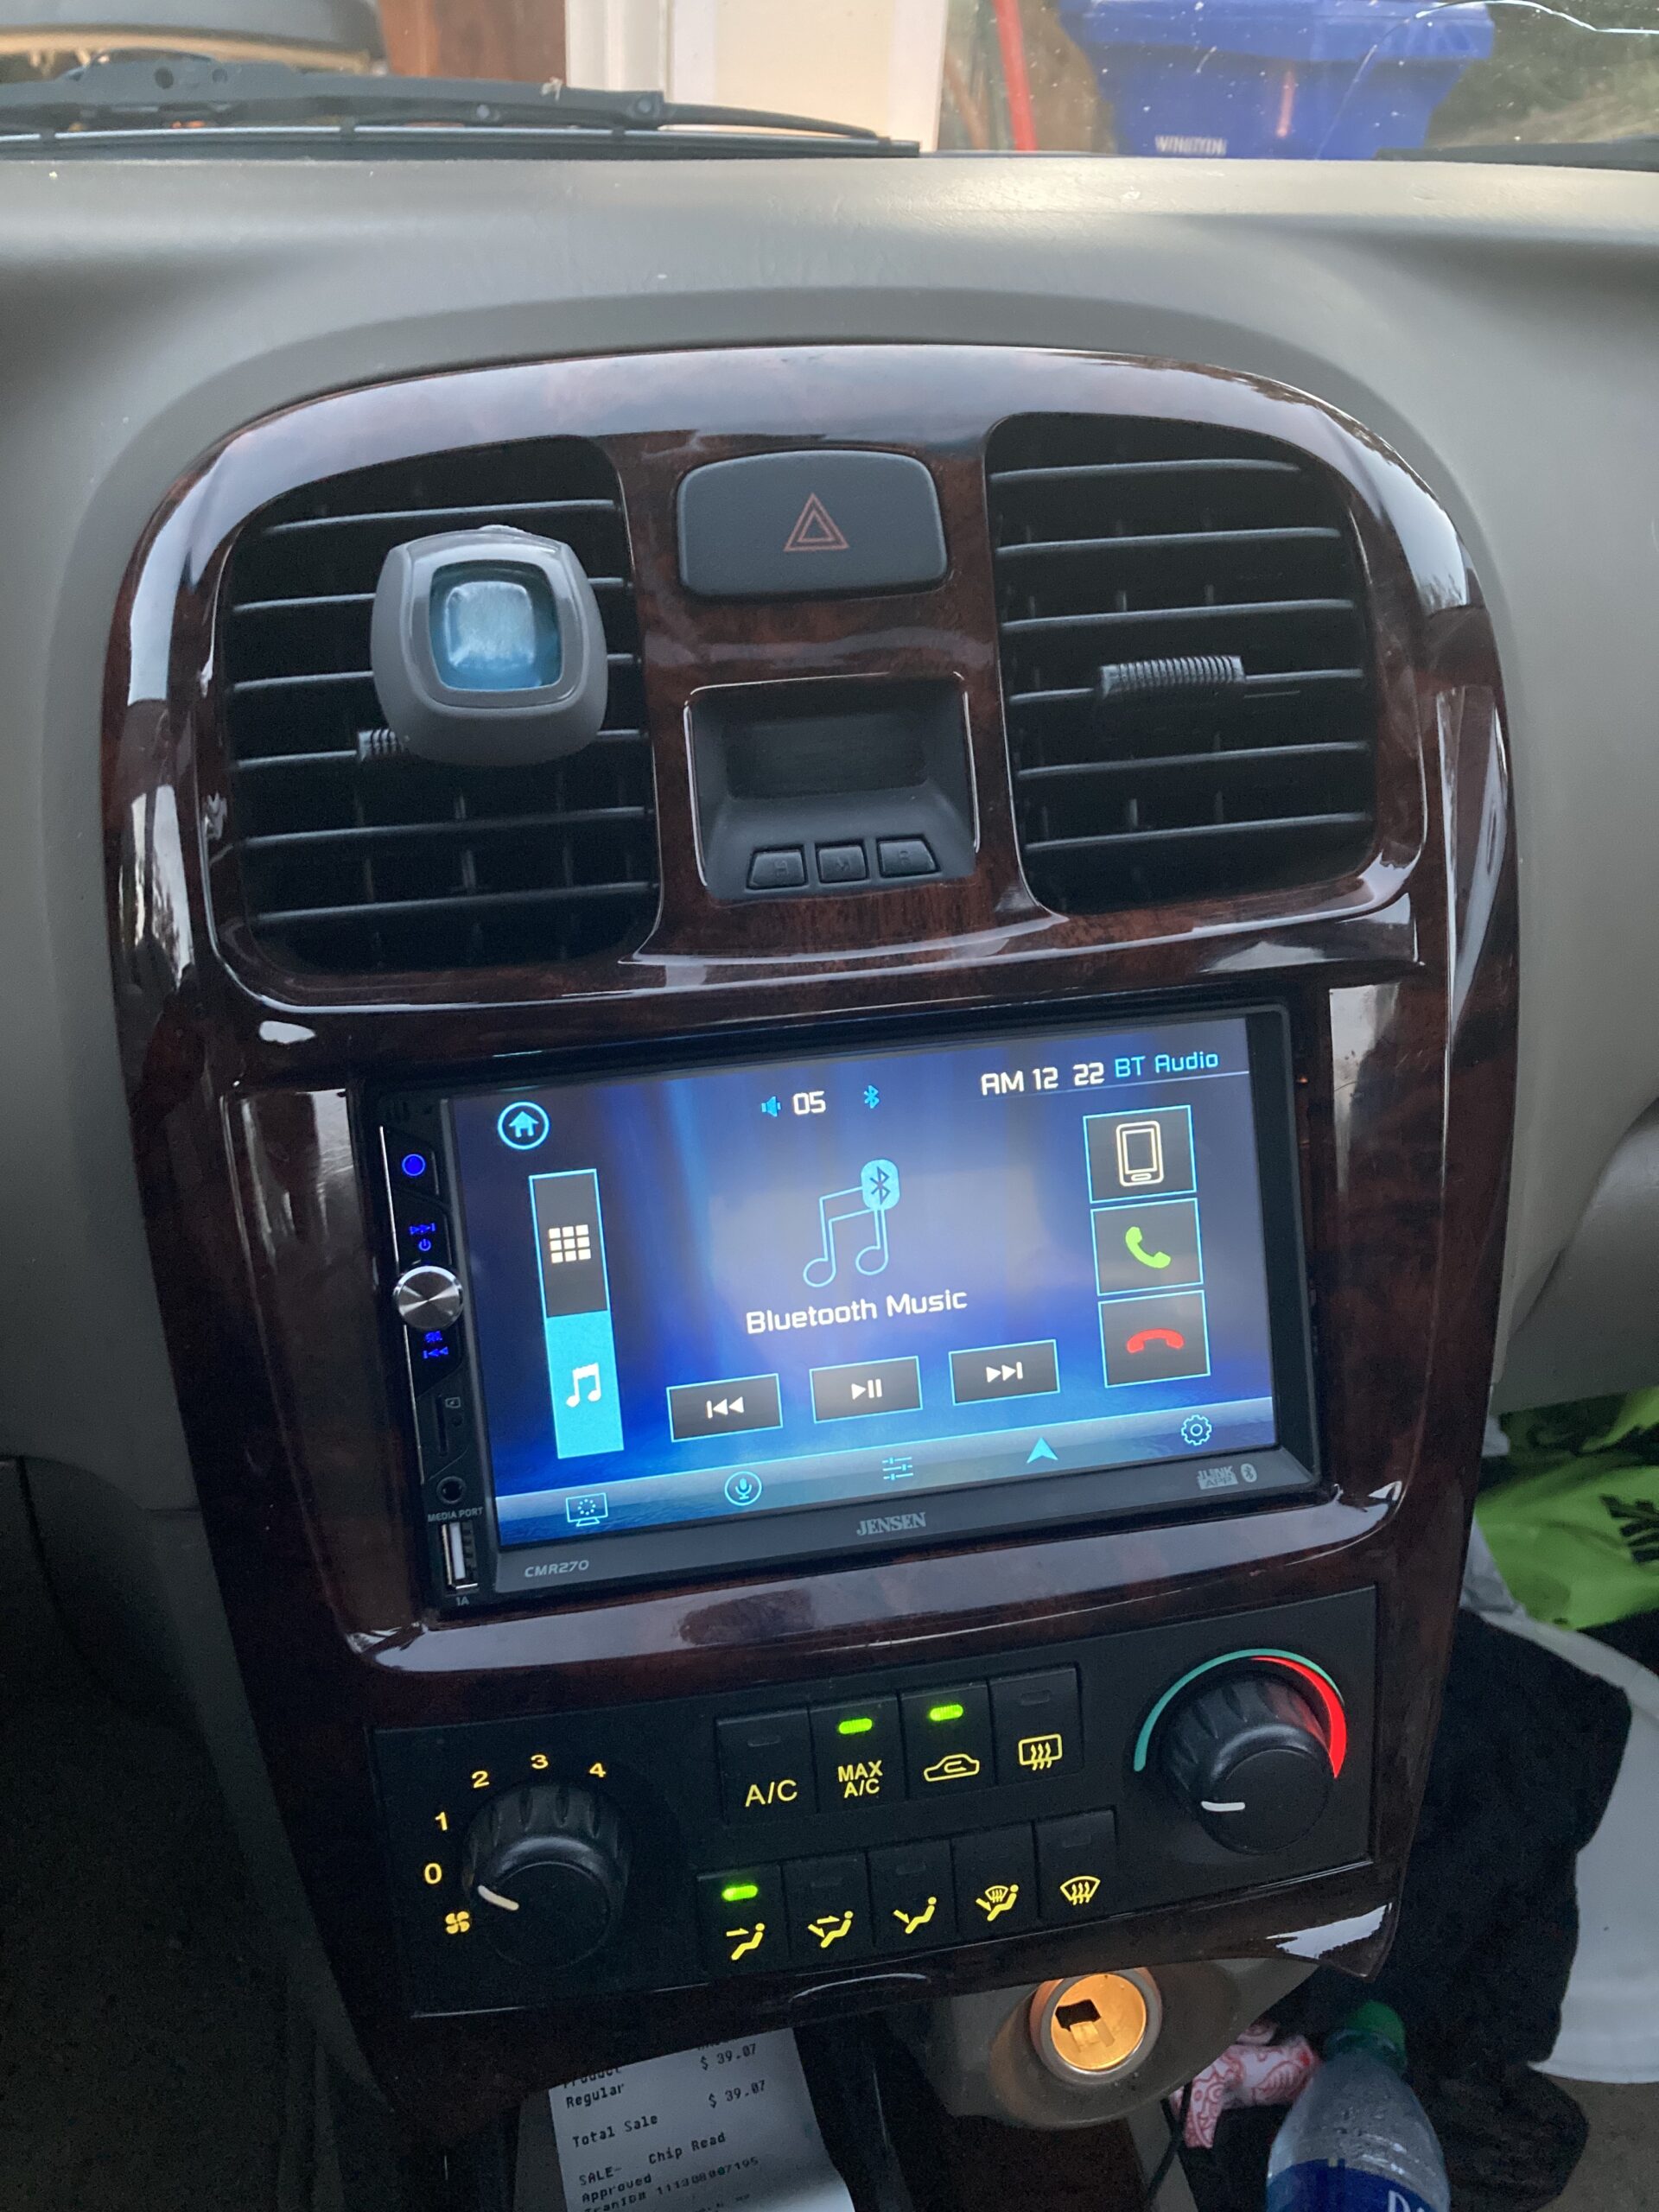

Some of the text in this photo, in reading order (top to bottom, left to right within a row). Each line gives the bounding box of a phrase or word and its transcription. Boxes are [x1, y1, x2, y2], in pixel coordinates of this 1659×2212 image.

[1115, 1051, 1219, 1078] BT Audio
[981, 1062, 1105, 1096] AM 12 22
[793, 1090, 827, 1116] 05
[746, 1289, 968, 1335] Bluetooth Music
[428, 1506, 484, 1522] MEDIA PORT
[856, 1512, 926, 1536] JENSEN
[524, 1560, 589, 1578] CMR270
[531, 1754, 550, 1770] 3
[589, 1763, 607, 1778] 4
[837, 1760, 884, 1783] MAX
[471, 1770, 490, 1789] 2
[843, 1778, 880, 1799] A/C
[745, 1779, 798, 1808] A/C
[435, 1811, 448, 1832] 1
[423, 1862, 443, 1885] 0
[566, 2083, 625, 2108] Regular
[700, 2056, 709, 2071] $
[716, 2043, 756, 2064] 39.07
[573, 2080, 766, 2147] Total Sale $ 39.07
[579, 2132, 726, 2186] SALE- Chip Read
[582, 2173, 652, 2203] Approved
